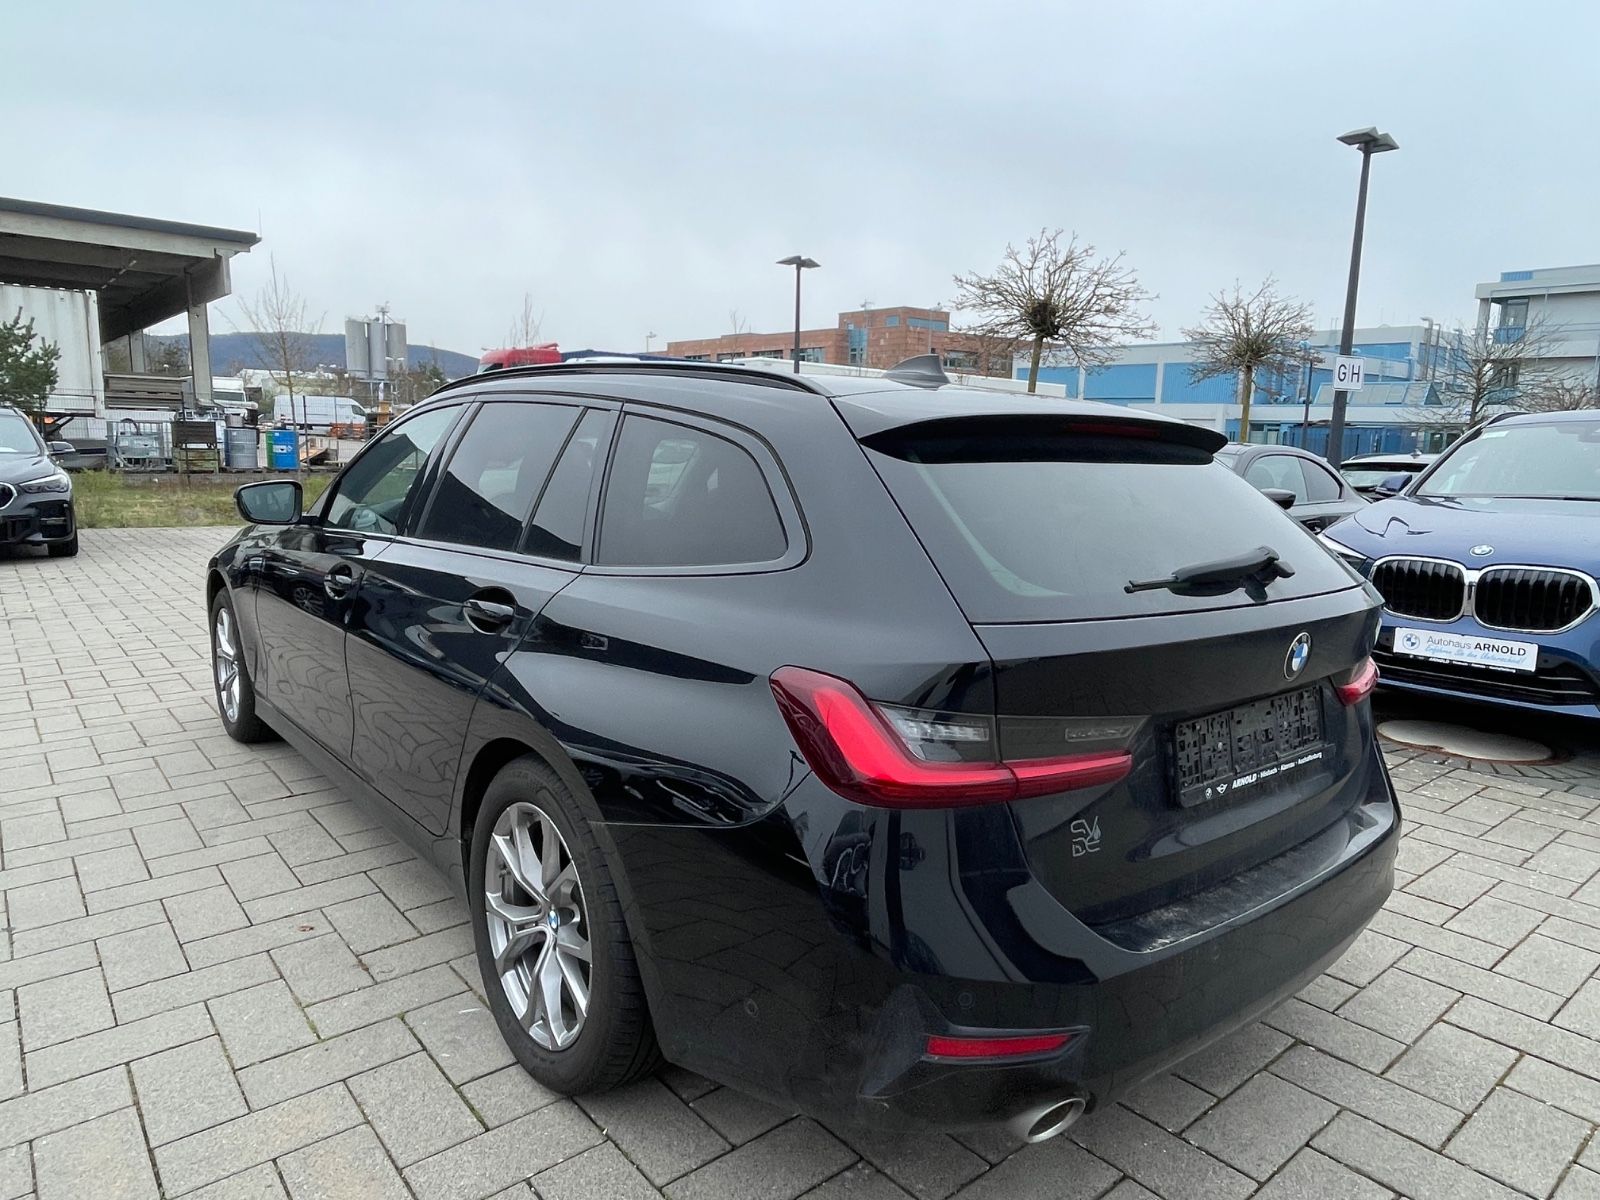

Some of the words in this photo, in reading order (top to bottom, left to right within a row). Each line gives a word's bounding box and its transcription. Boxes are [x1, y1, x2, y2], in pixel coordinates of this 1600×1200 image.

[1427, 635, 1471, 649] Autohaus
[1474, 642, 1526, 657] ARNOLD
[1231, 773, 1257, 789] ARNOLD
